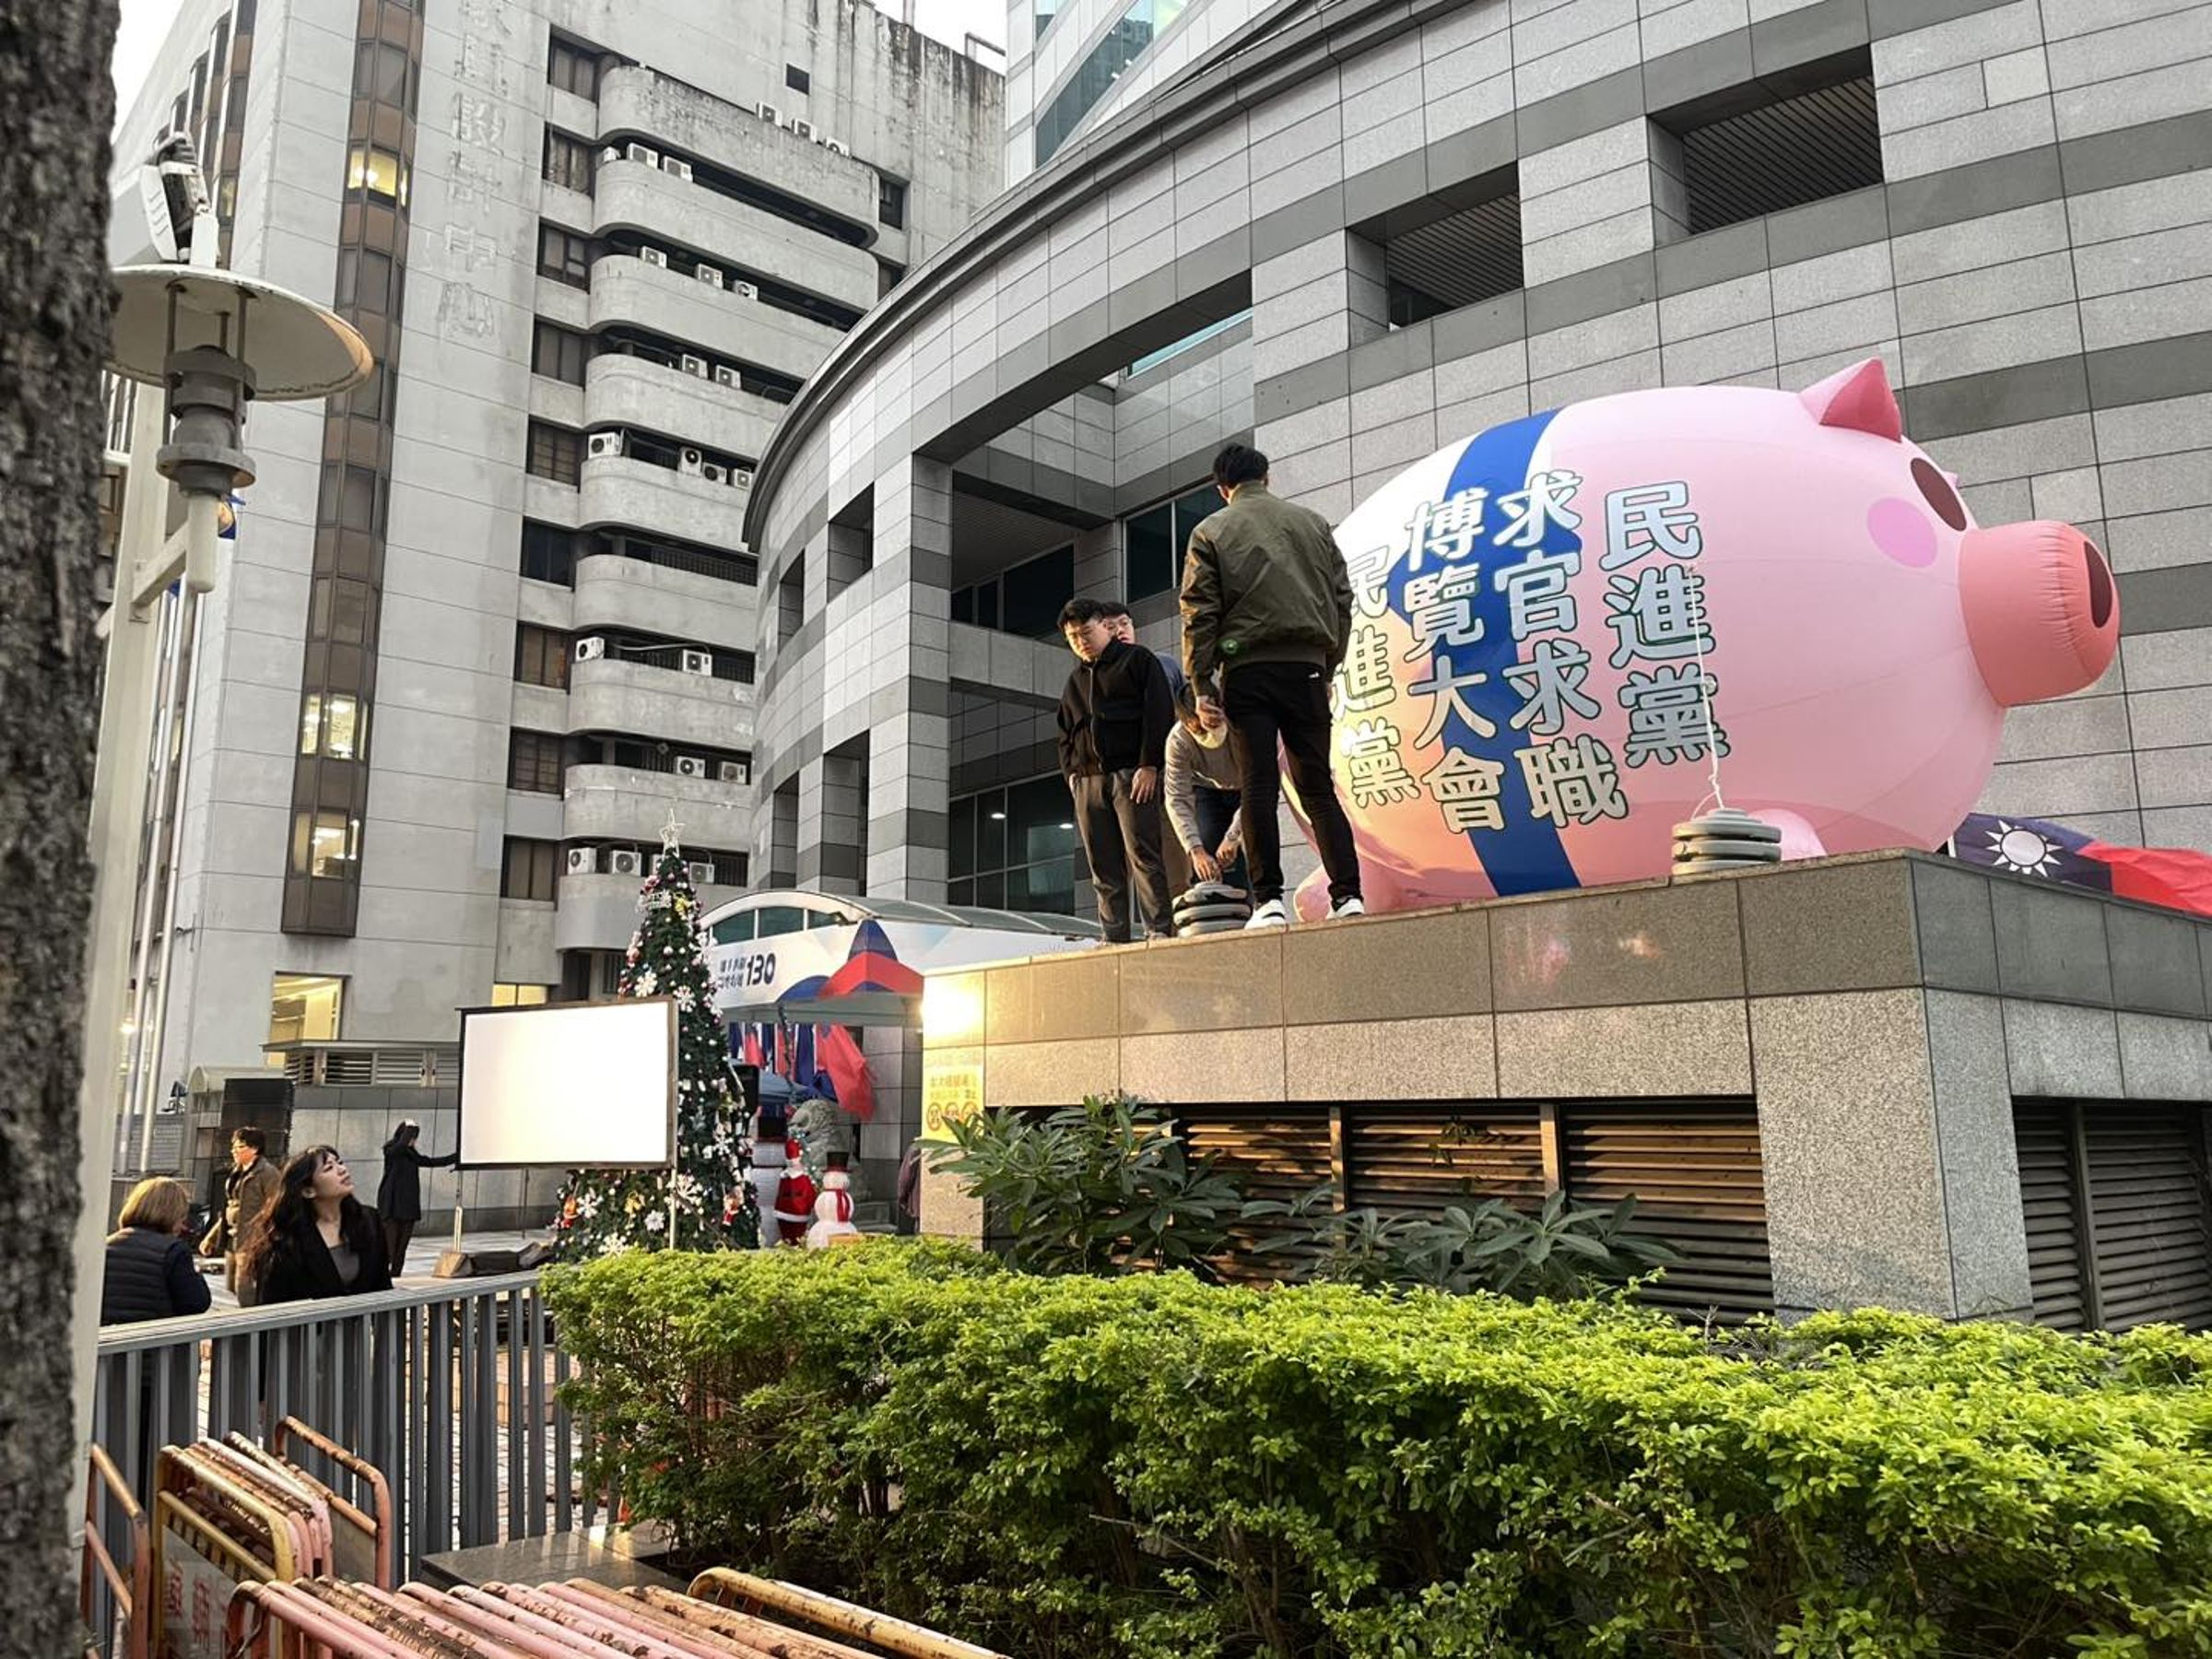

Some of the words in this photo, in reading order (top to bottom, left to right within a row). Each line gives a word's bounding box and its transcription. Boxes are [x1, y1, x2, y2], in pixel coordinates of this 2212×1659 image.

[1402, 488, 1505, 833] 博覽大會
[1493, 470, 1629, 827] 求官求職
[1599, 481, 1730, 769] 民進黨
[747, 952, 776, 986] 130
